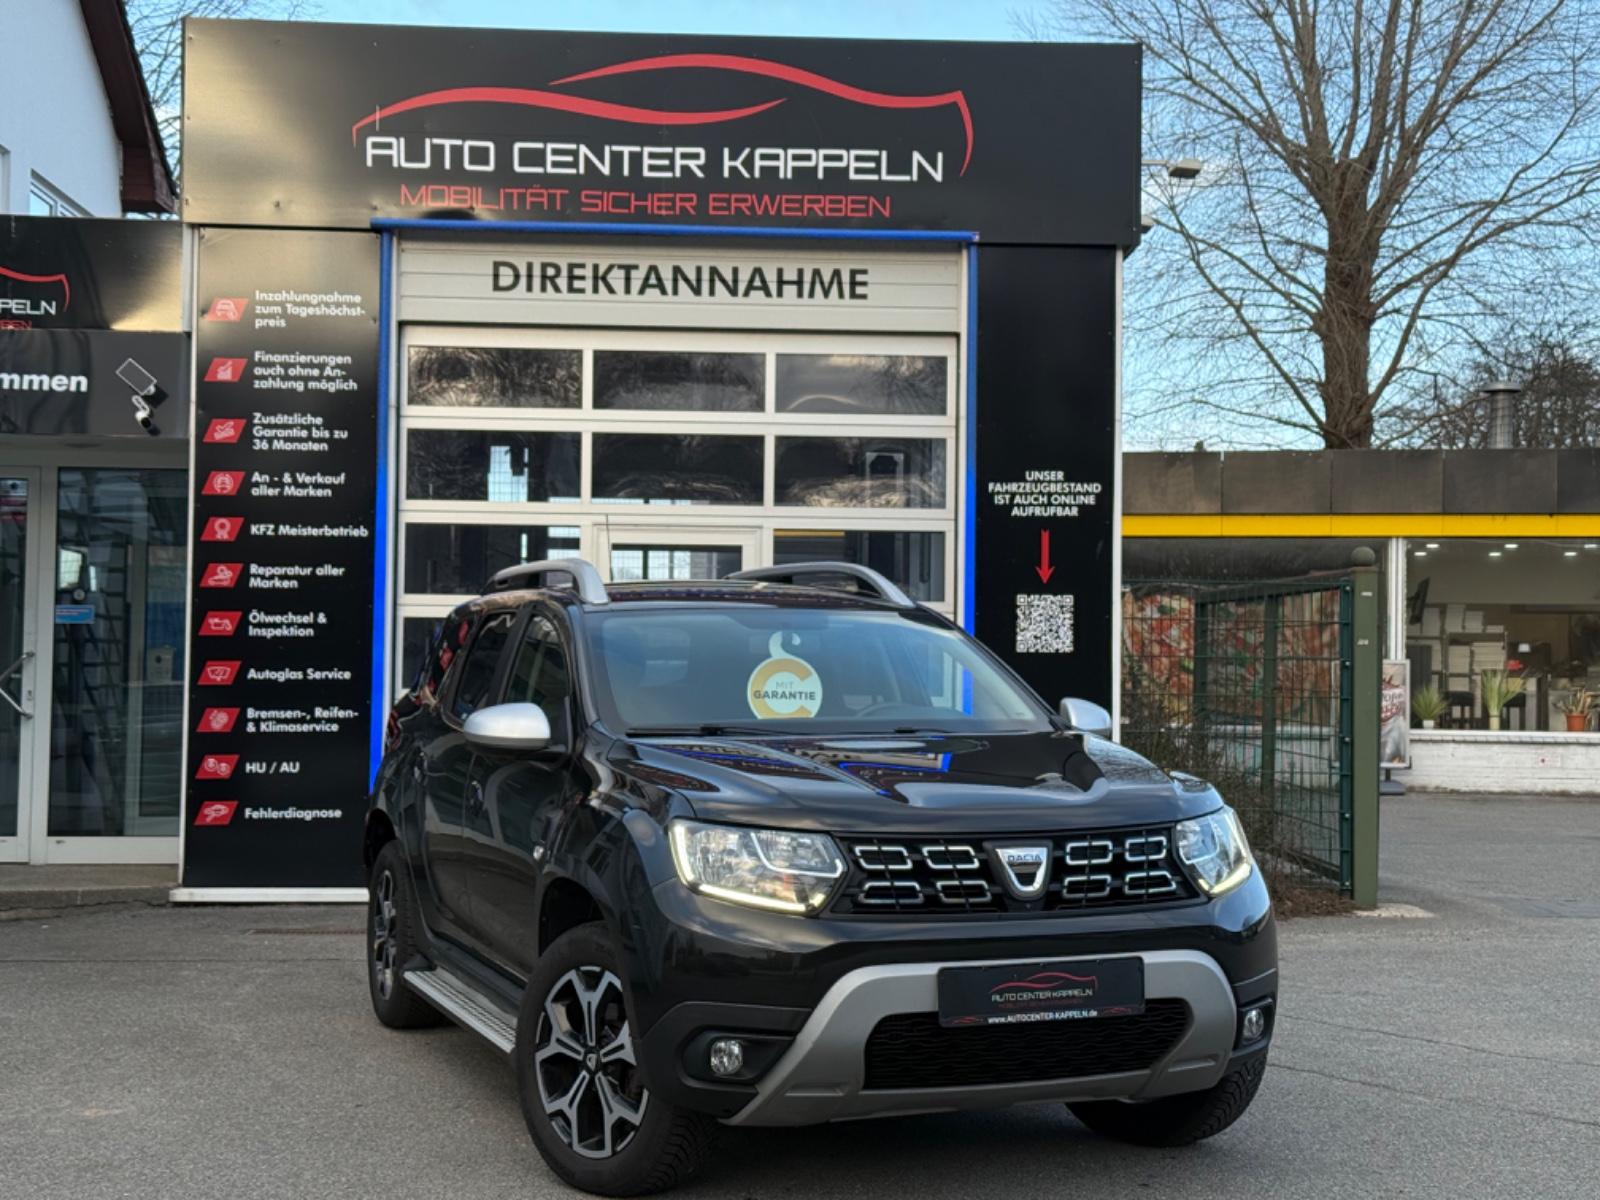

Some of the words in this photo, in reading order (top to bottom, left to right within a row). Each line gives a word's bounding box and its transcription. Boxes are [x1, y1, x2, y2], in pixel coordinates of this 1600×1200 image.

[366, 136, 495, 172] AUTO
[513, 142, 706, 178] CENTER
[723, 147, 943, 182] KAPPELN
[401, 183, 569, 210] MOBILITÄT
[581, 191, 697, 216] SICHER
[709, 194, 890, 218] ERWERBEN
[492, 260, 868, 300] DIREKTANNAHME
[255, 290, 362, 305] Inzahlungnahme
[255, 305, 282, 315] zum
[285, 303, 366, 317] Tageshöchst-
[255, 317, 286, 329] preis
[254, 351, 352, 366] Finanzierungen
[254, 366, 285, 376] auch
[288, 366, 320, 377] ohne
[323, 367, 347, 377] An-
[253, 378, 304, 392] zahlung
[308, 379, 358, 392] möglich
[252, 412, 323, 425] Zusätzliche
[252, 426, 308, 438] Garantie
[312, 428, 330, 439] bis
[333, 429, 348, 439] zu
[252, 440, 269, 450] 36
[272, 440, 329, 451] Monaten
[251, 472, 270, 483] An
[282, 472, 293, 484] &
[296, 473, 346, 485] Verkauf
[1025, 471, 1064, 482] UNSER
[251, 485, 281, 496] aller
[283, 485, 332, 497] Marken
[988, 482, 1102, 494] FAHRZEUGBESTAND
[994, 494, 1012, 505] IST
[1014, 495, 1047, 505] AUCH
[1050, 495, 1096, 505] ONLINE
[1011, 506, 1079, 517] AUFRUFBAR
[250, 524, 275, 536] KFZ
[278, 525, 369, 537] Meisterbetrieb
[249, 563, 313, 577] Reparatur
[315, 564, 345, 576] aller
[249, 577, 298, 589] Marken
[249, 609, 314, 624] Ölwechsel
[317, 612, 327, 624] &
[248, 625, 314, 639] Inspektion
[247, 668, 303, 682] Autoglas
[306, 668, 352, 680] Service
[776, 681, 794, 689] MIT
[753, 690, 816, 701] GARANTIE
[246, 707, 311, 720] Bremsen-,
[314, 707, 359, 718] Reifen-
[246, 722, 256, 733] &
[260, 721, 339, 732] Klimaservice
[245, 761, 266, 773] HU
[269, 761, 276, 774] /
[279, 761, 300, 773] AU
[244, 807, 342, 821] Fehlerdiagnose
[1007, 853, 1042, 862] DACIA
[992, 993, 1016, 1003] AUTO
[1017, 990, 1051, 1001] CENTER
[1052, 988, 1093, 999] KAPPELN
